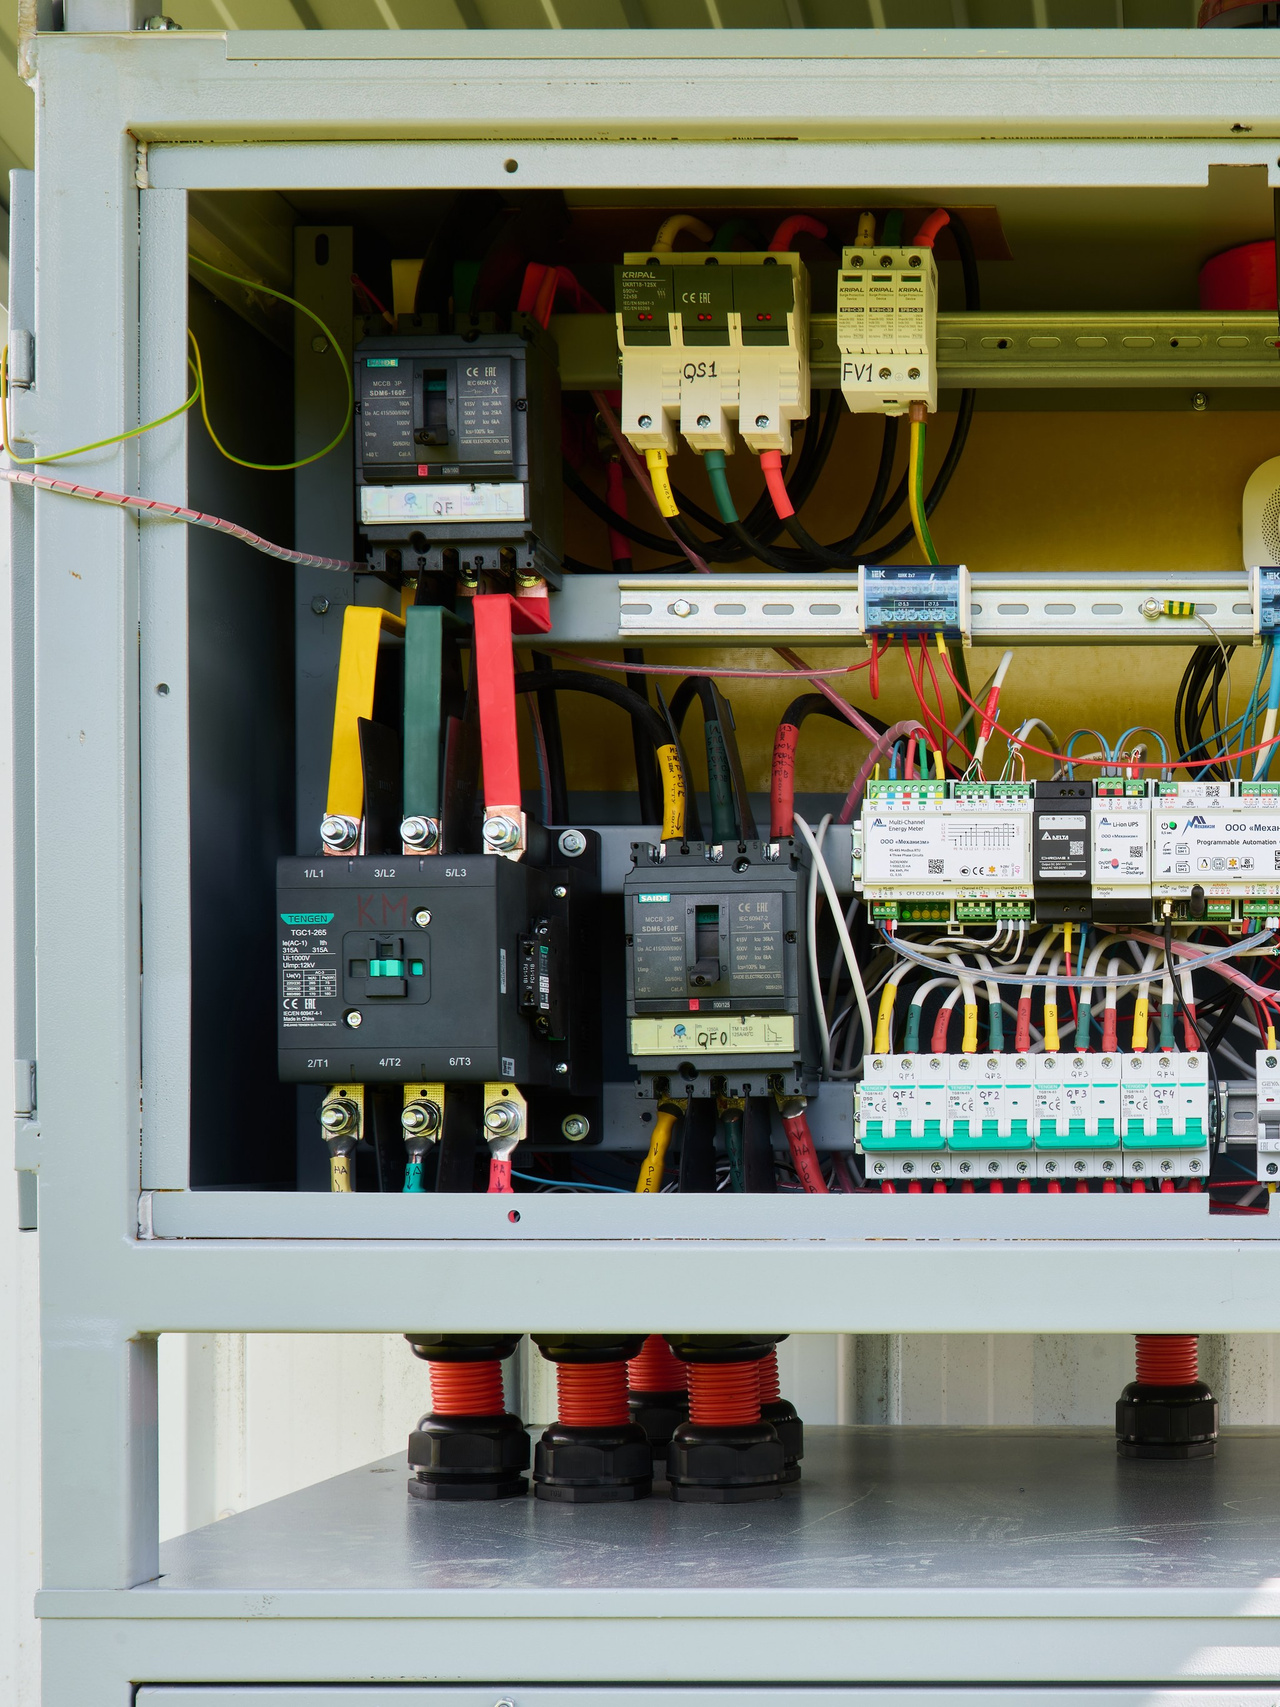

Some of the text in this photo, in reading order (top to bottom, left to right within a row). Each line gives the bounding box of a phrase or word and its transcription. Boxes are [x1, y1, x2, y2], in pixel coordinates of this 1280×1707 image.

[683, 361, 718, 383] QS1
[843, 363, 873, 382] FV1
[432, 501, 453, 515] QF
[871, 570, 885, 578] IEK
[1266, 572, 1280, 580] IEK
[303, 869, 467, 878] 1/L1 3/L2 5/L3
[357, 893, 408, 926] KM
[288, 915, 328, 923] TENGEN
[307, 1057, 471, 1068] 2/T1 4/T2 6/T3
[899, 1072, 915, 1080] QF1
[985, 1072, 1002, 1080] QF2
[1071, 1070, 1088, 1078] QF3
[1156, 1070, 1174, 1078] QF4
[893, 1091, 914, 1099] QF1
[979, 1091, 1000, 1100] QF2
[1066, 1090, 1087, 1099] QF3
[1154, 1089, 1174, 1098] QF4
